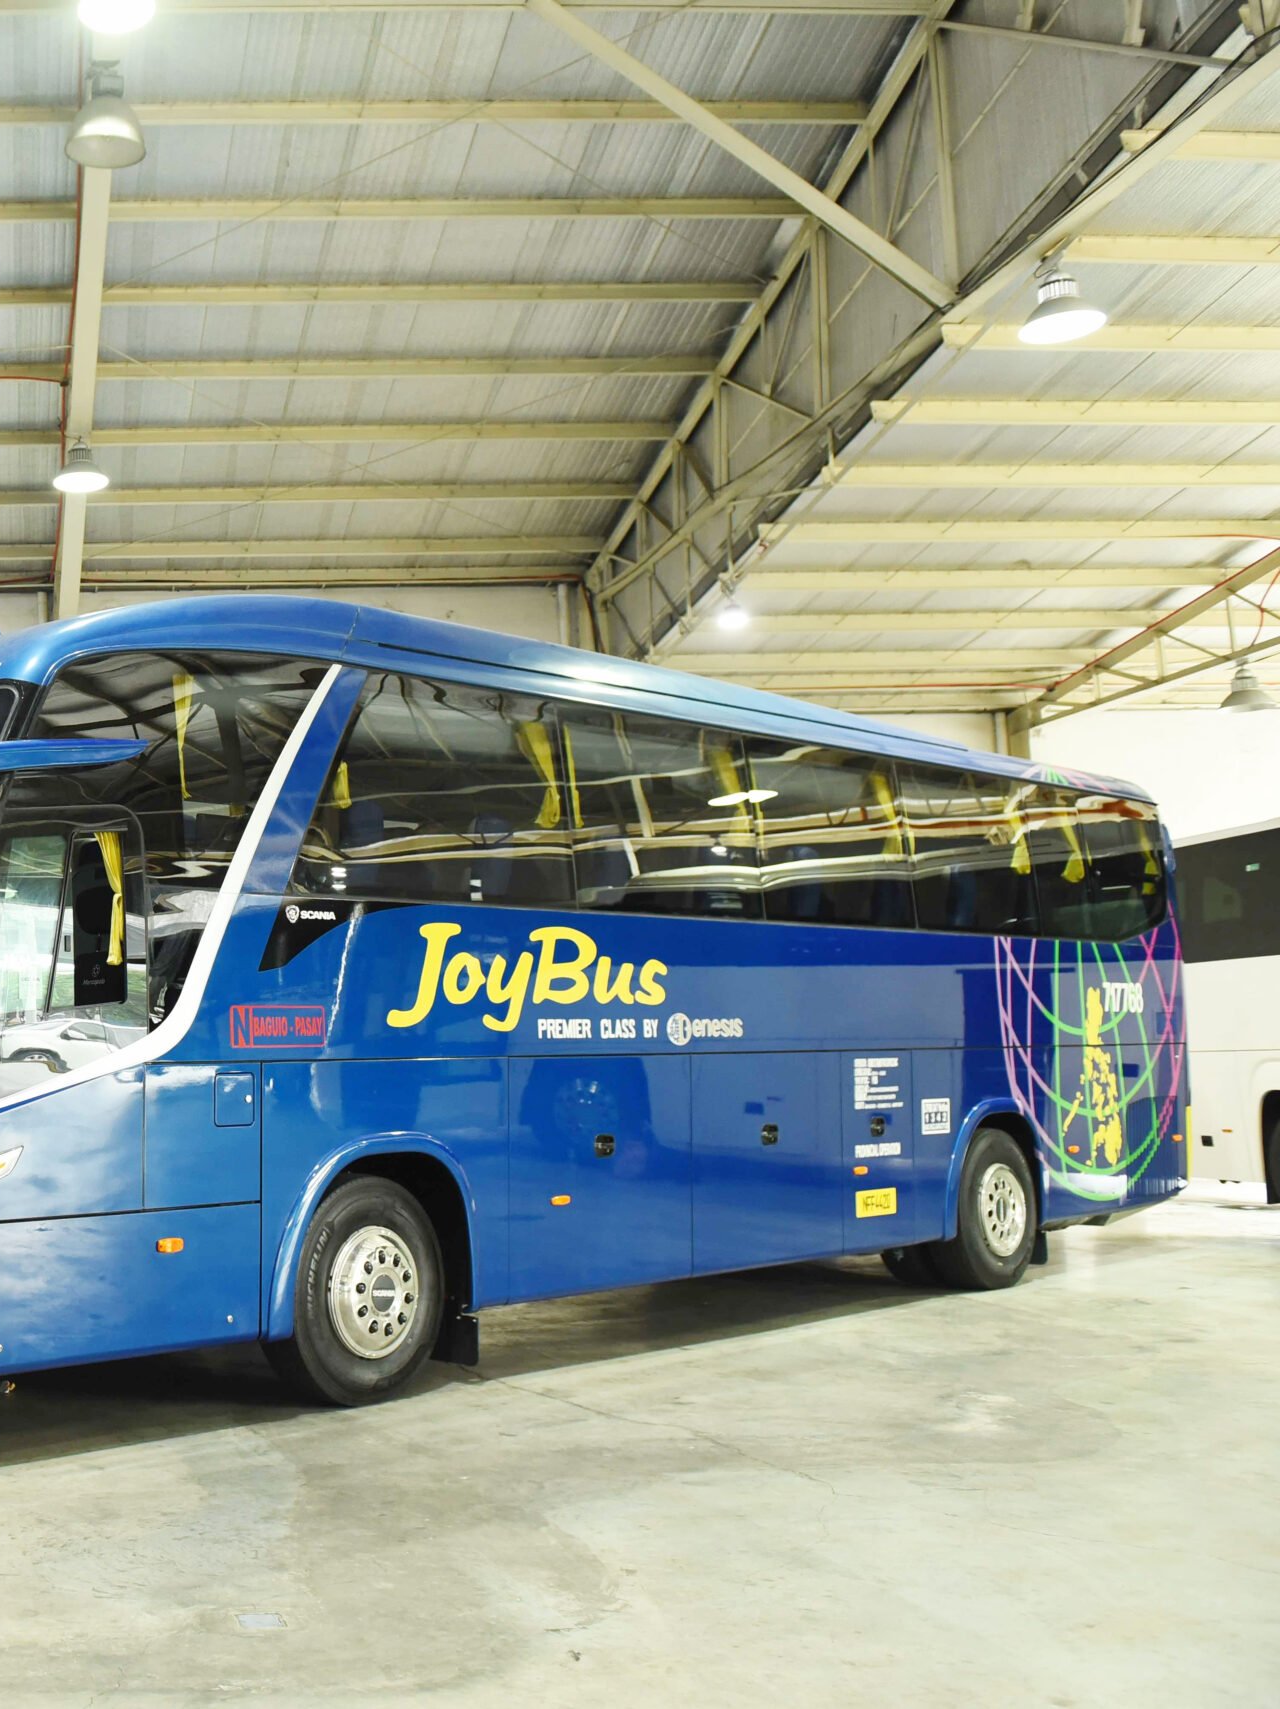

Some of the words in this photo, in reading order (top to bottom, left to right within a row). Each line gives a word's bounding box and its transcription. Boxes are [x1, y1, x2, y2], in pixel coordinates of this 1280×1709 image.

[300, 910, 336, 921] SCANIA
[386, 922, 669, 1032] JoyBus
[254, 1016, 288, 1037] BAGUIO
[295, 1015, 324, 1036] PASAY
[537, 1018, 592, 1039] PREMIER
[600, 1018, 636, 1039] CLASS
[643, 1018, 658, 1038] BY
